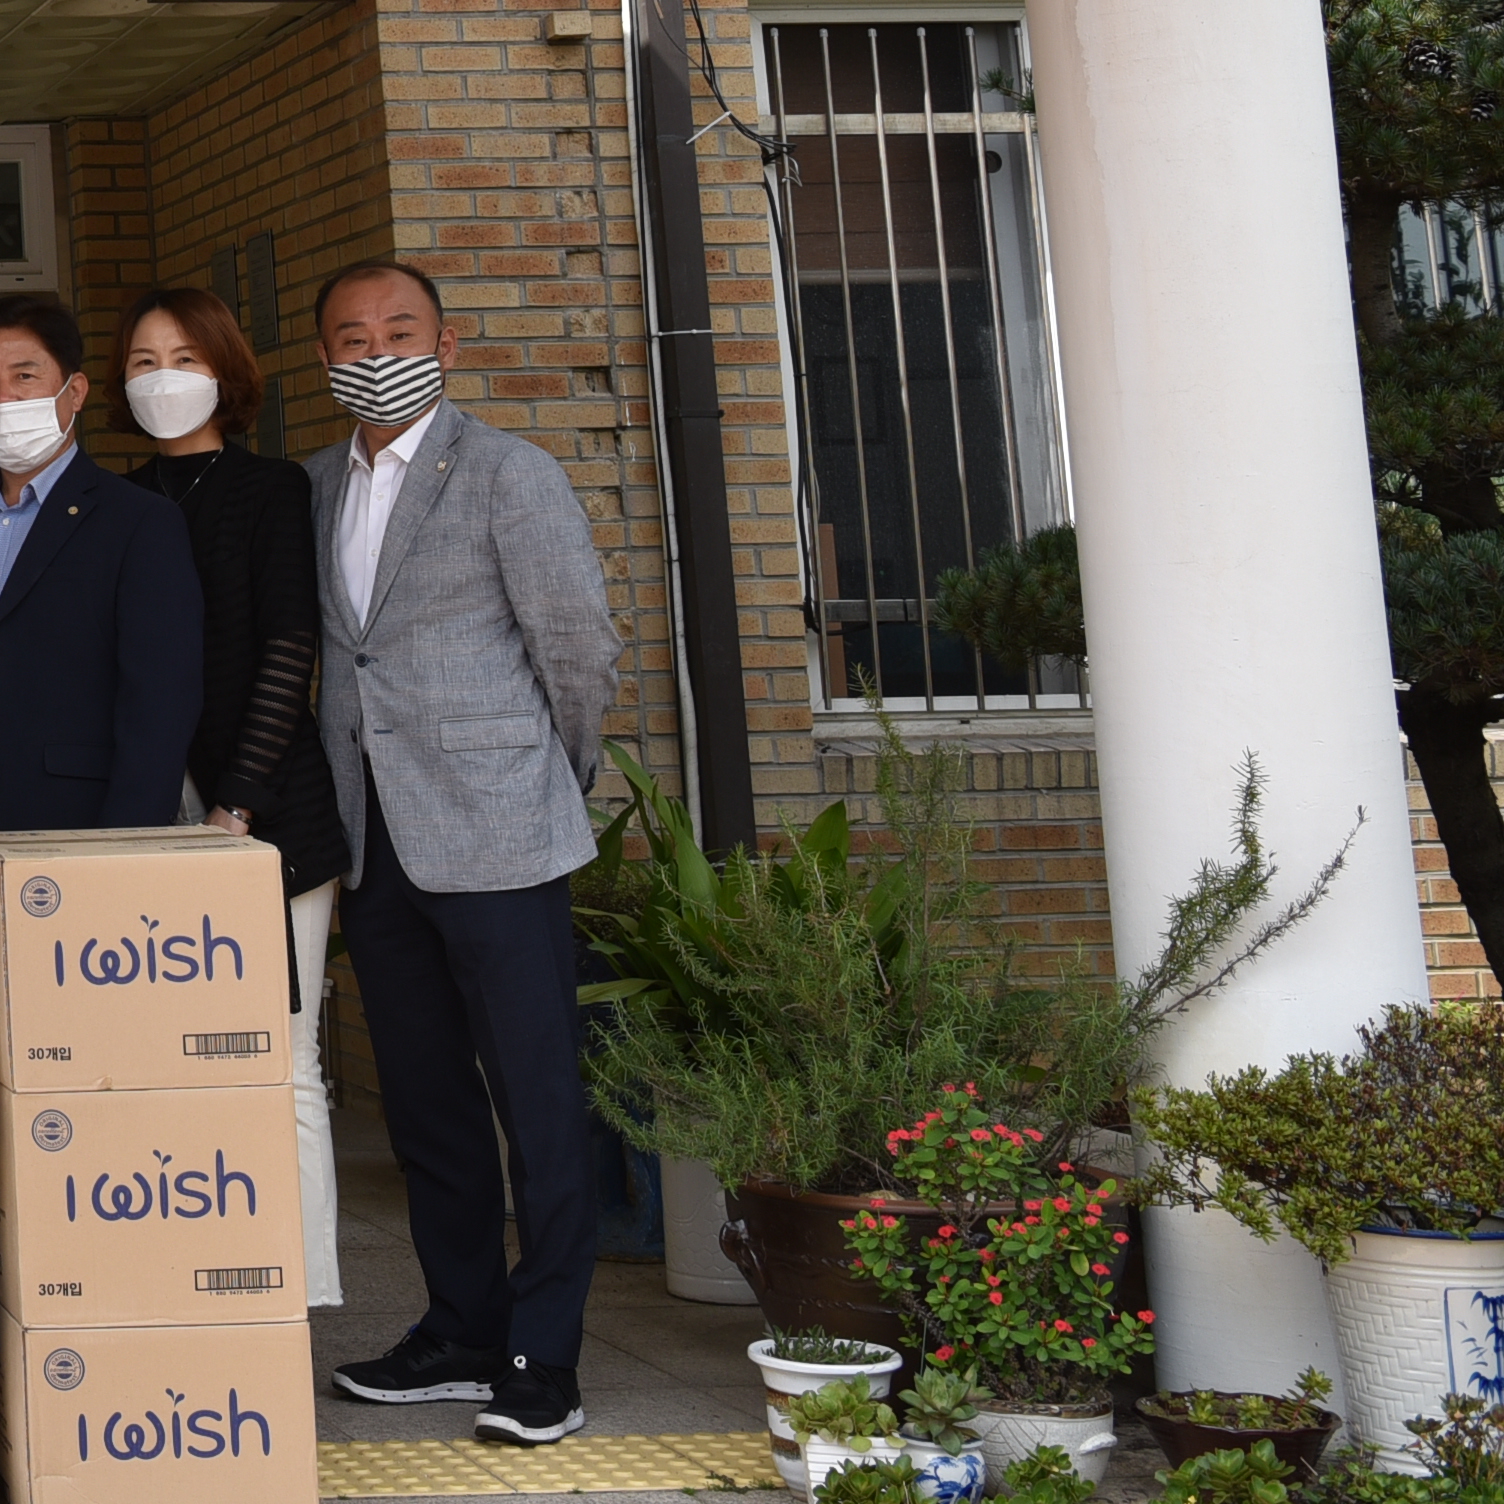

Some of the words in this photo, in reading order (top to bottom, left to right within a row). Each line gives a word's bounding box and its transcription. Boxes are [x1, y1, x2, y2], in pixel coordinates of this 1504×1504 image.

[54, 940, 64, 987] I
[79, 913, 243, 985] wish
[27, 1047, 72, 1061] 30개입
[66, 1174, 76, 1222] I
[91, 1148, 256, 1221] wish
[38, 1282, 82, 1297] 30개입
[78, 1413, 88, 1462] I
[103, 1387, 271, 1460] wish
